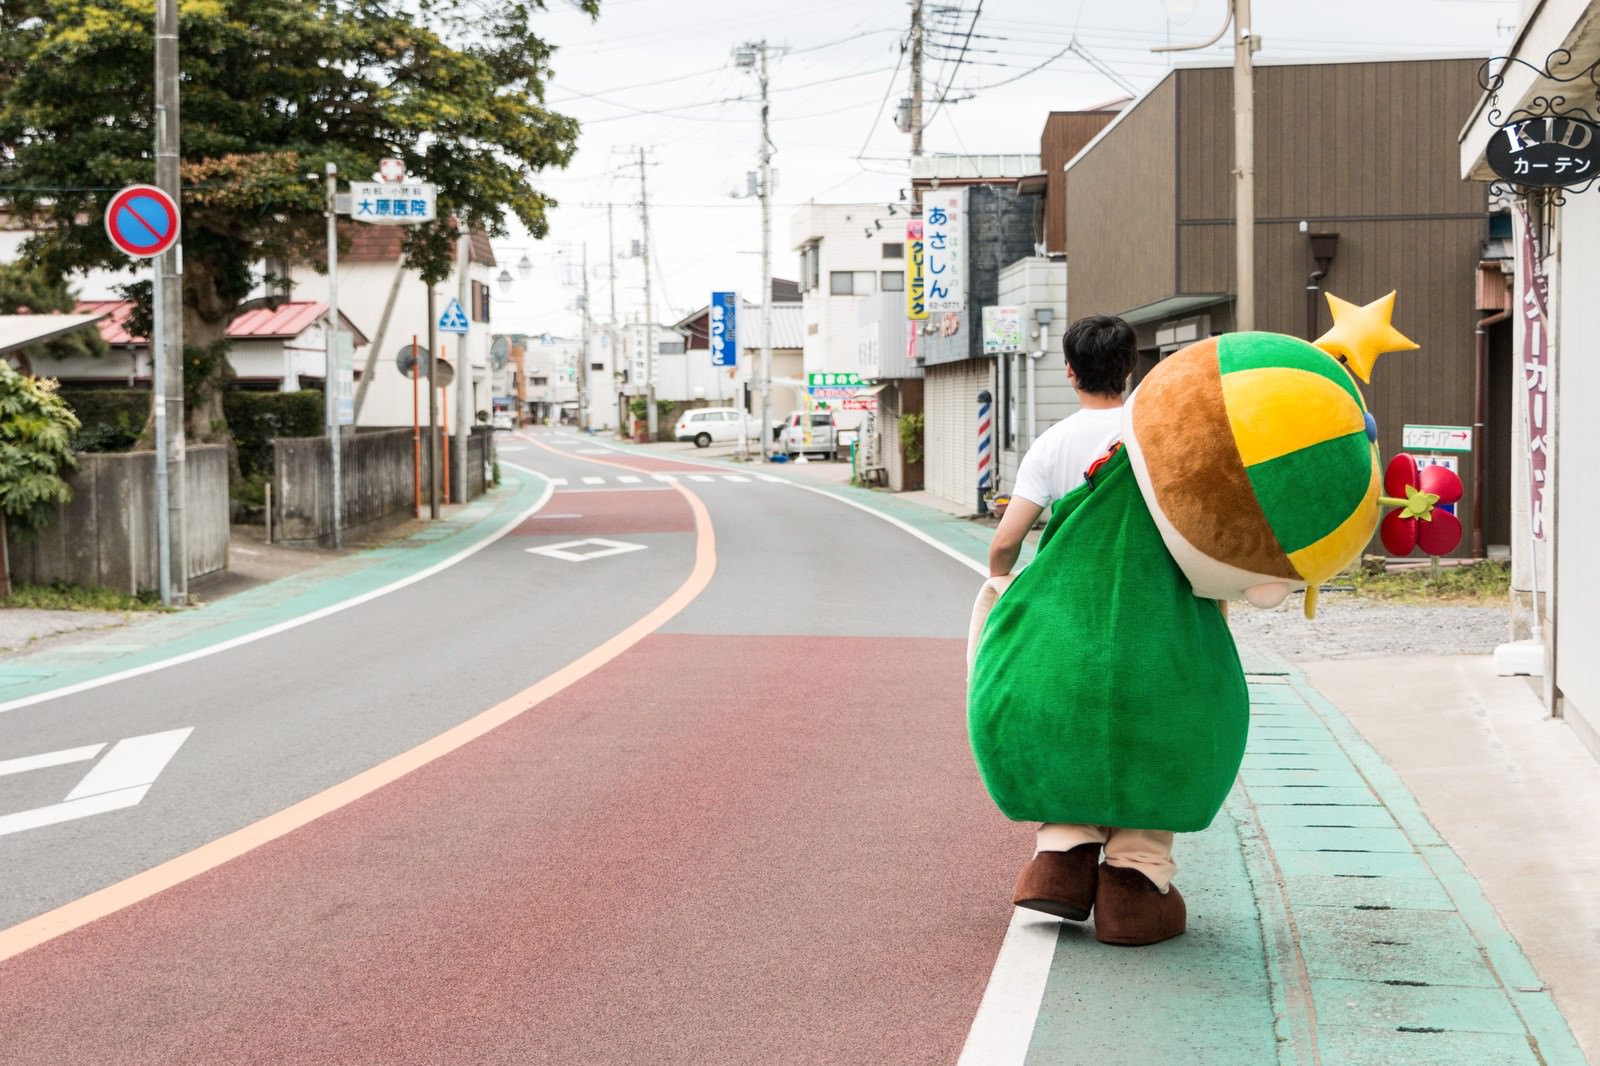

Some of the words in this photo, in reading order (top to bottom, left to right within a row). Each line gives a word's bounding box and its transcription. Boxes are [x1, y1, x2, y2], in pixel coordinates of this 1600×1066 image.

[1503, 117, 1593, 153] KID
[1514, 157, 1591, 174] カーテン
[358, 199, 427, 216] 大原医院
[928, 206, 949, 299] あさしん
[1404, 430, 1451, 447] インテリア
